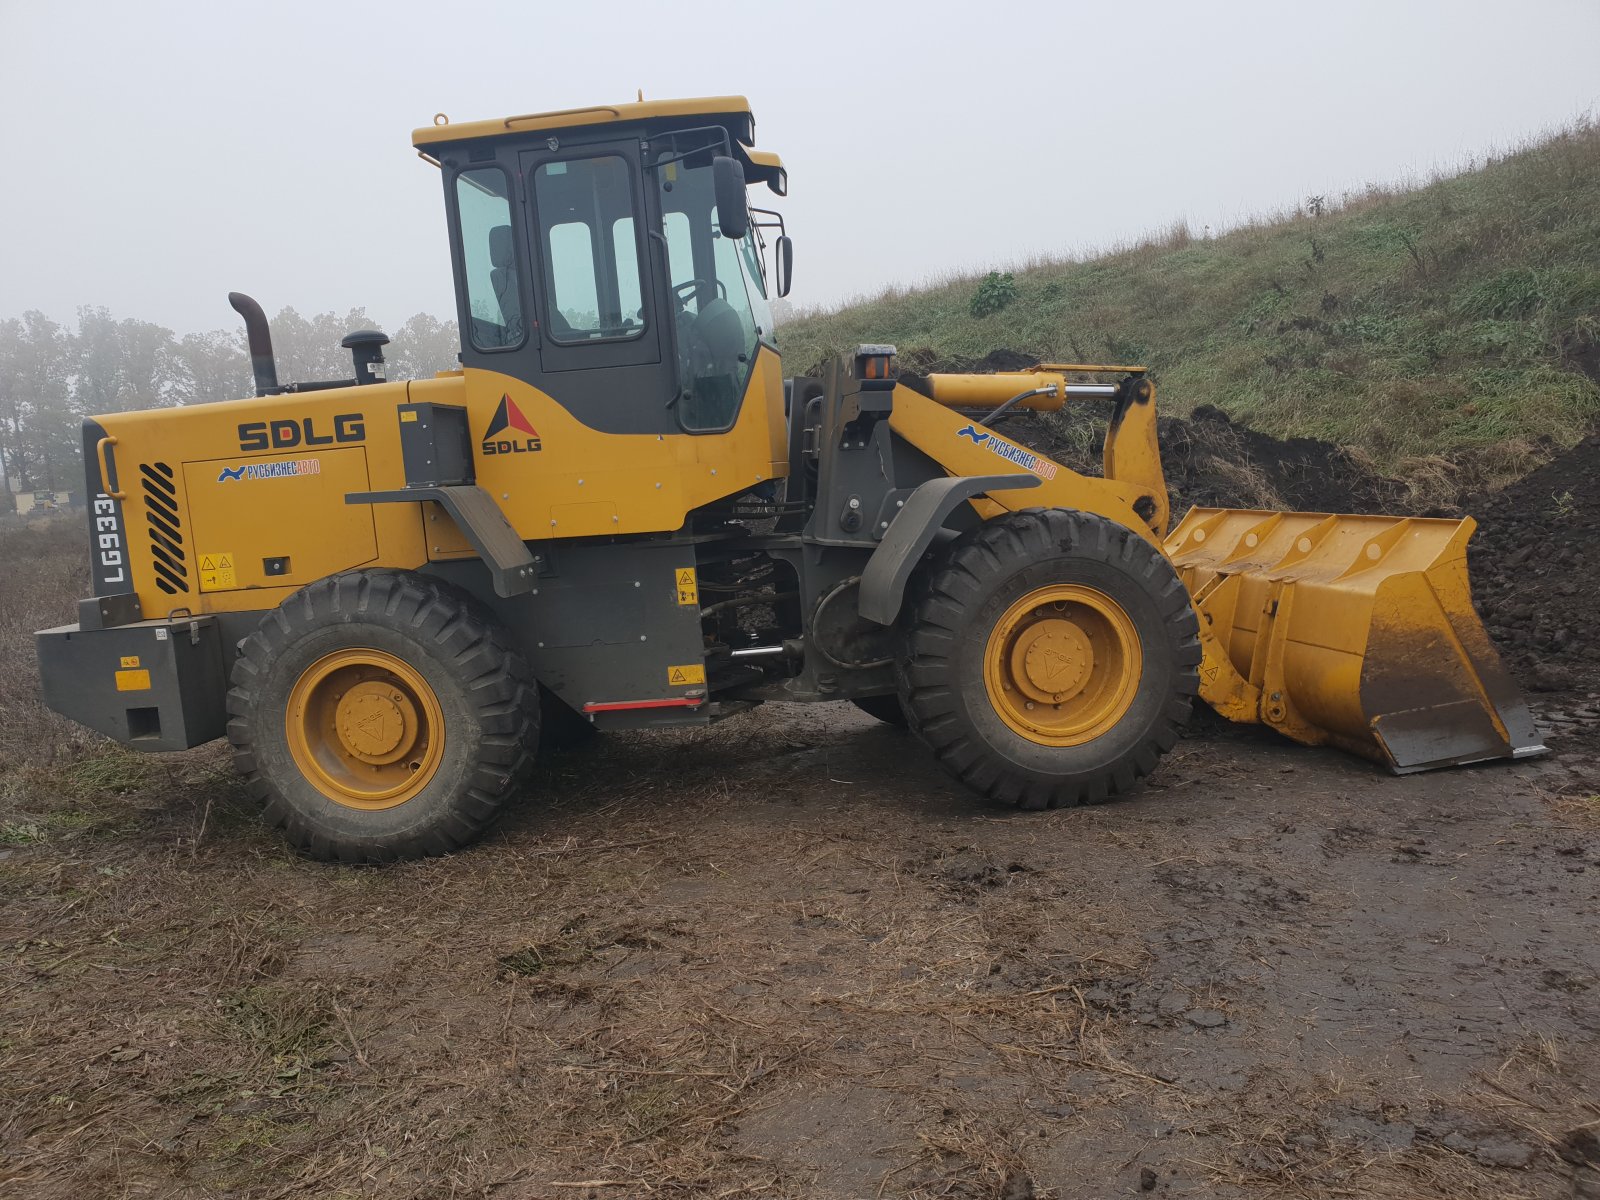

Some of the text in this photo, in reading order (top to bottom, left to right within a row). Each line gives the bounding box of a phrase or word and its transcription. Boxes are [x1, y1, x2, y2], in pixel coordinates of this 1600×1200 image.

[238, 413, 366, 451] SDLG
[482, 438, 542, 455] SDLG
[247, 459, 320, 479] РУСБИЗНЕСАВТО
[986, 436, 1057, 480] РУСБИЗНЕСАВТО
